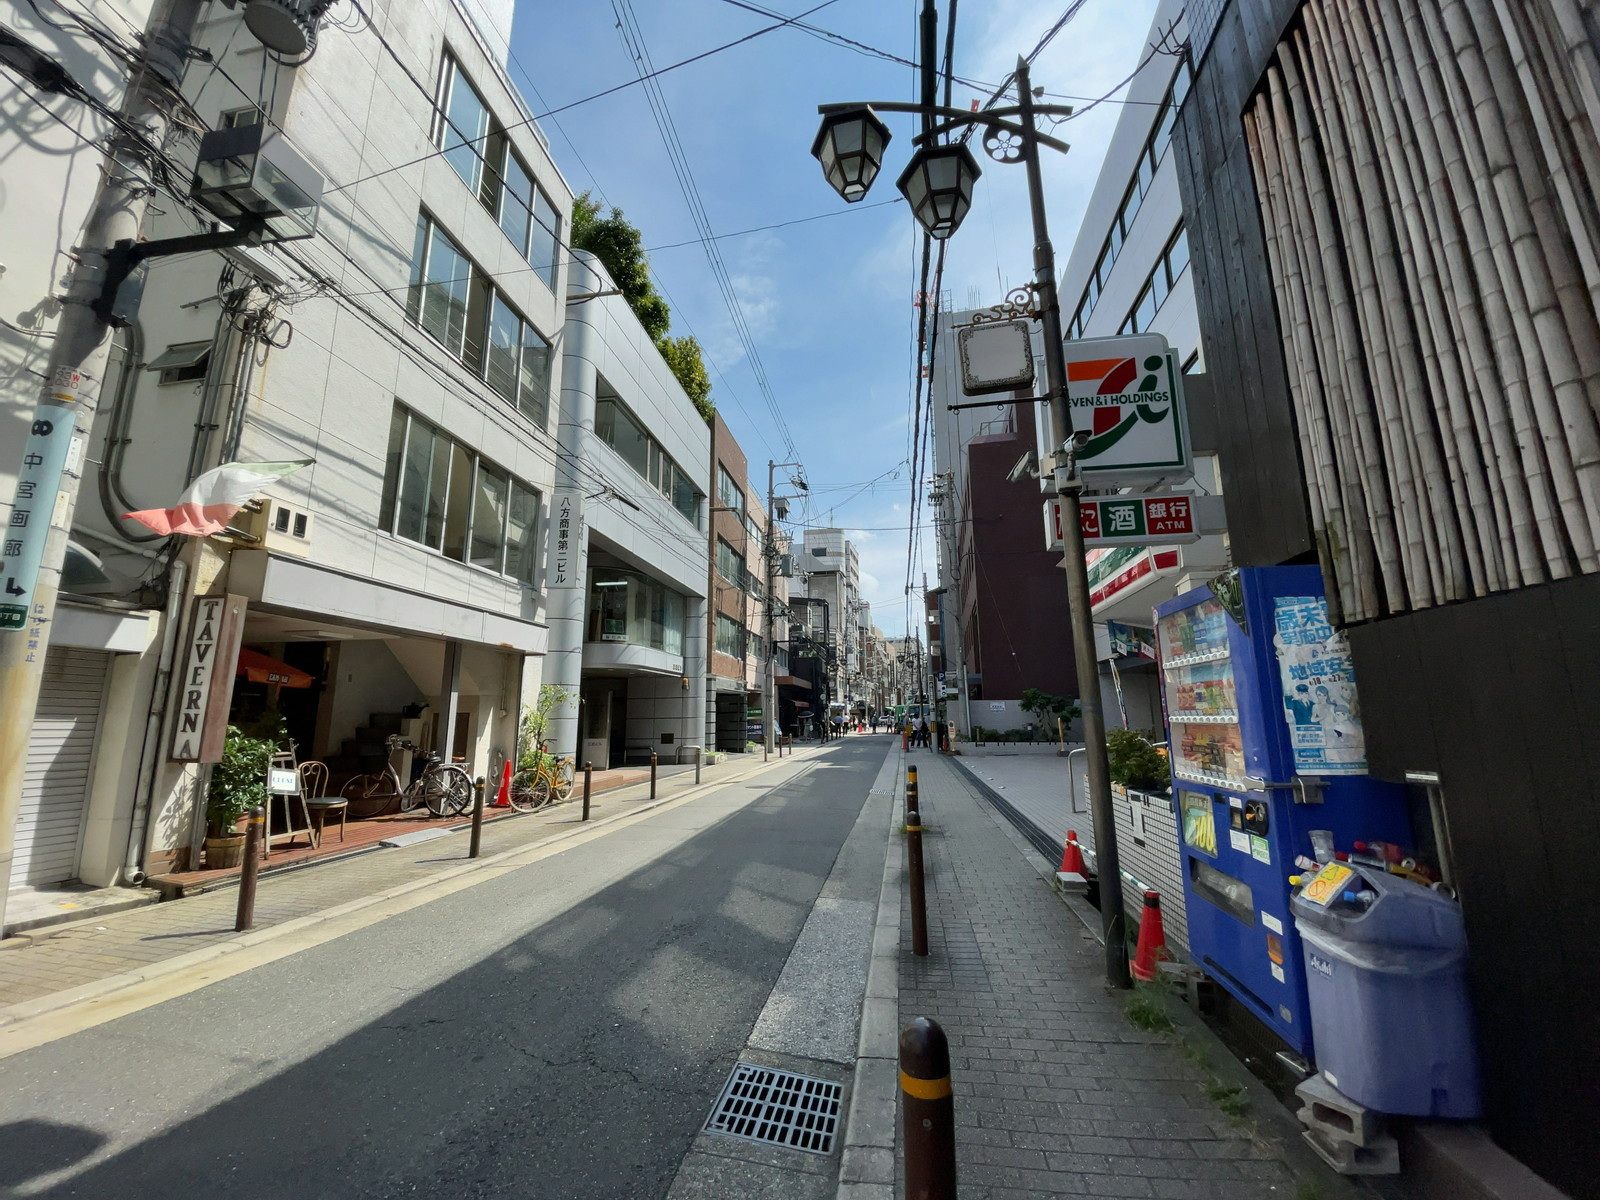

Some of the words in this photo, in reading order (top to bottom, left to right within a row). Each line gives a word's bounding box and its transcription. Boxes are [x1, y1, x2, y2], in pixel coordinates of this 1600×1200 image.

[1068, 396, 1107, 408] EVEN&i
[1111, 392, 1168, 405] HOLDINGS
[1108, 505, 1136, 532] 酒
[1148, 502, 1187, 519] 銀行
[1156, 520, 1185, 530] ATM
[555, 497, 571, 584] 八方商事第二ビル
[0, 612, 21, 621] 丁目
[179, 600, 219, 759] TAVERNA
